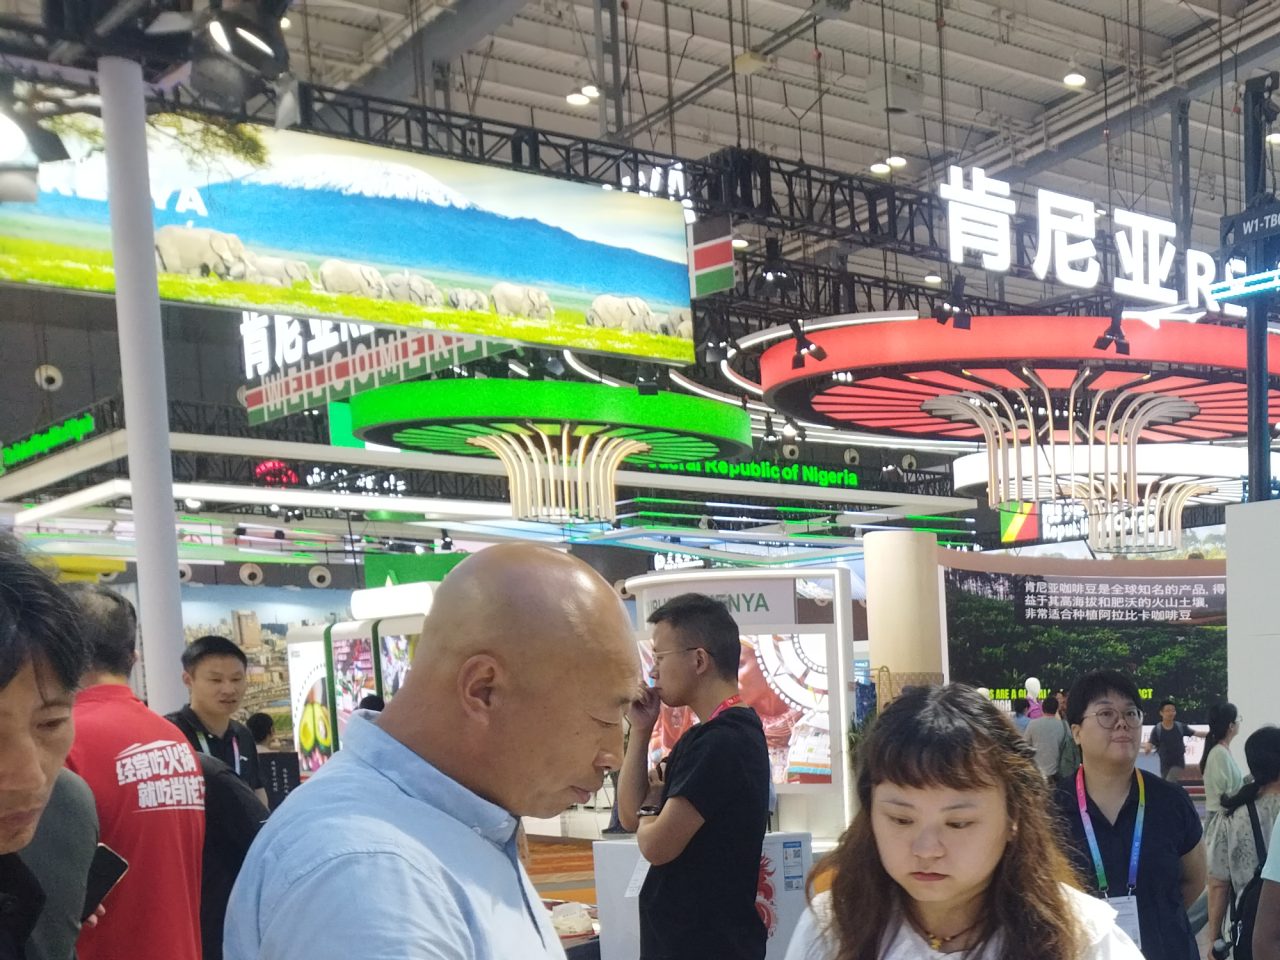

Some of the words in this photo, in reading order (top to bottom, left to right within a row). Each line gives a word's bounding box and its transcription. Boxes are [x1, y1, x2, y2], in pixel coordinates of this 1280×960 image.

[940, 165, 1179, 304] 肯尼亚
[704, 460, 781, 479] Republic
[781, 464, 799, 481] of
[802, 465, 858, 486] Nigeria
[1025, 608, 1192, 621] 非常适合种植阿拉比卡咖啡豆
[116, 743, 197, 786] 经常吃火锅
